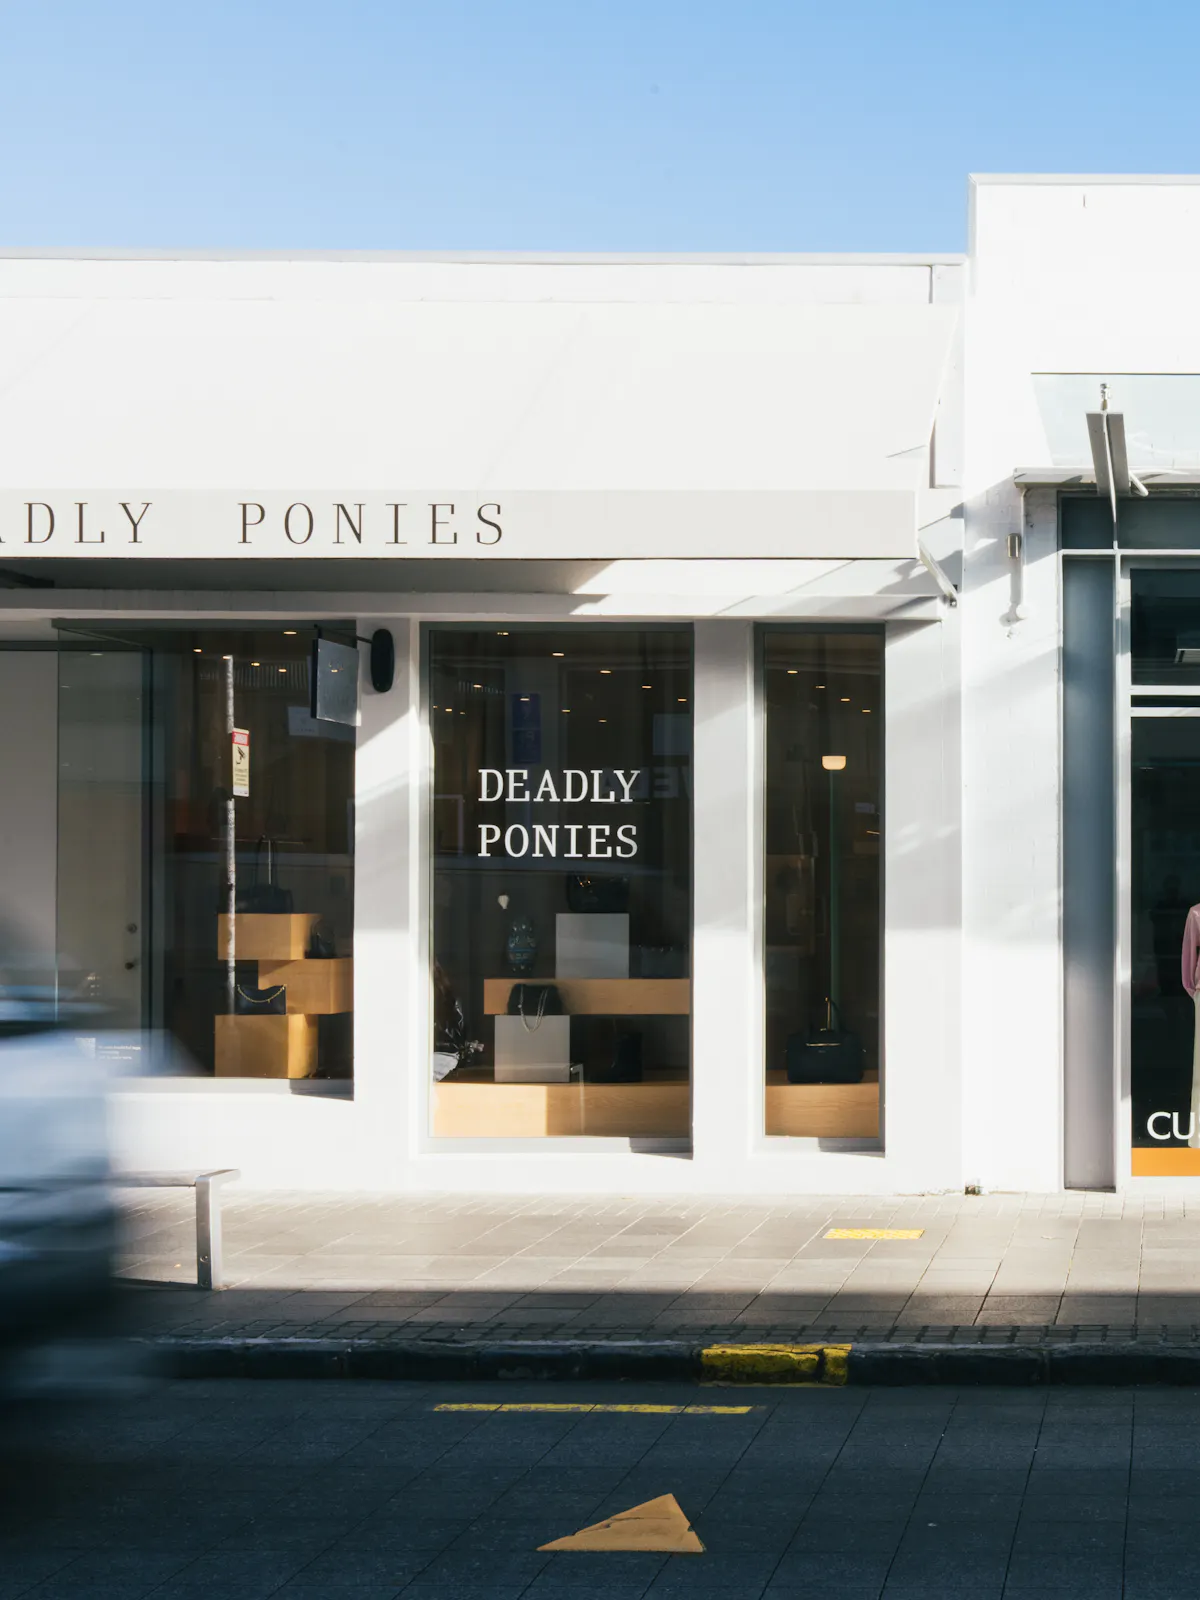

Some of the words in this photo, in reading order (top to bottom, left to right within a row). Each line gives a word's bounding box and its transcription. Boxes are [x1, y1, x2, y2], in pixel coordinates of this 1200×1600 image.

[0, 502, 153, 544] DLY
[237, 502, 503, 546] PONIES
[478, 769, 641, 803] DEADLY
[477, 824, 638, 858] PONIES
